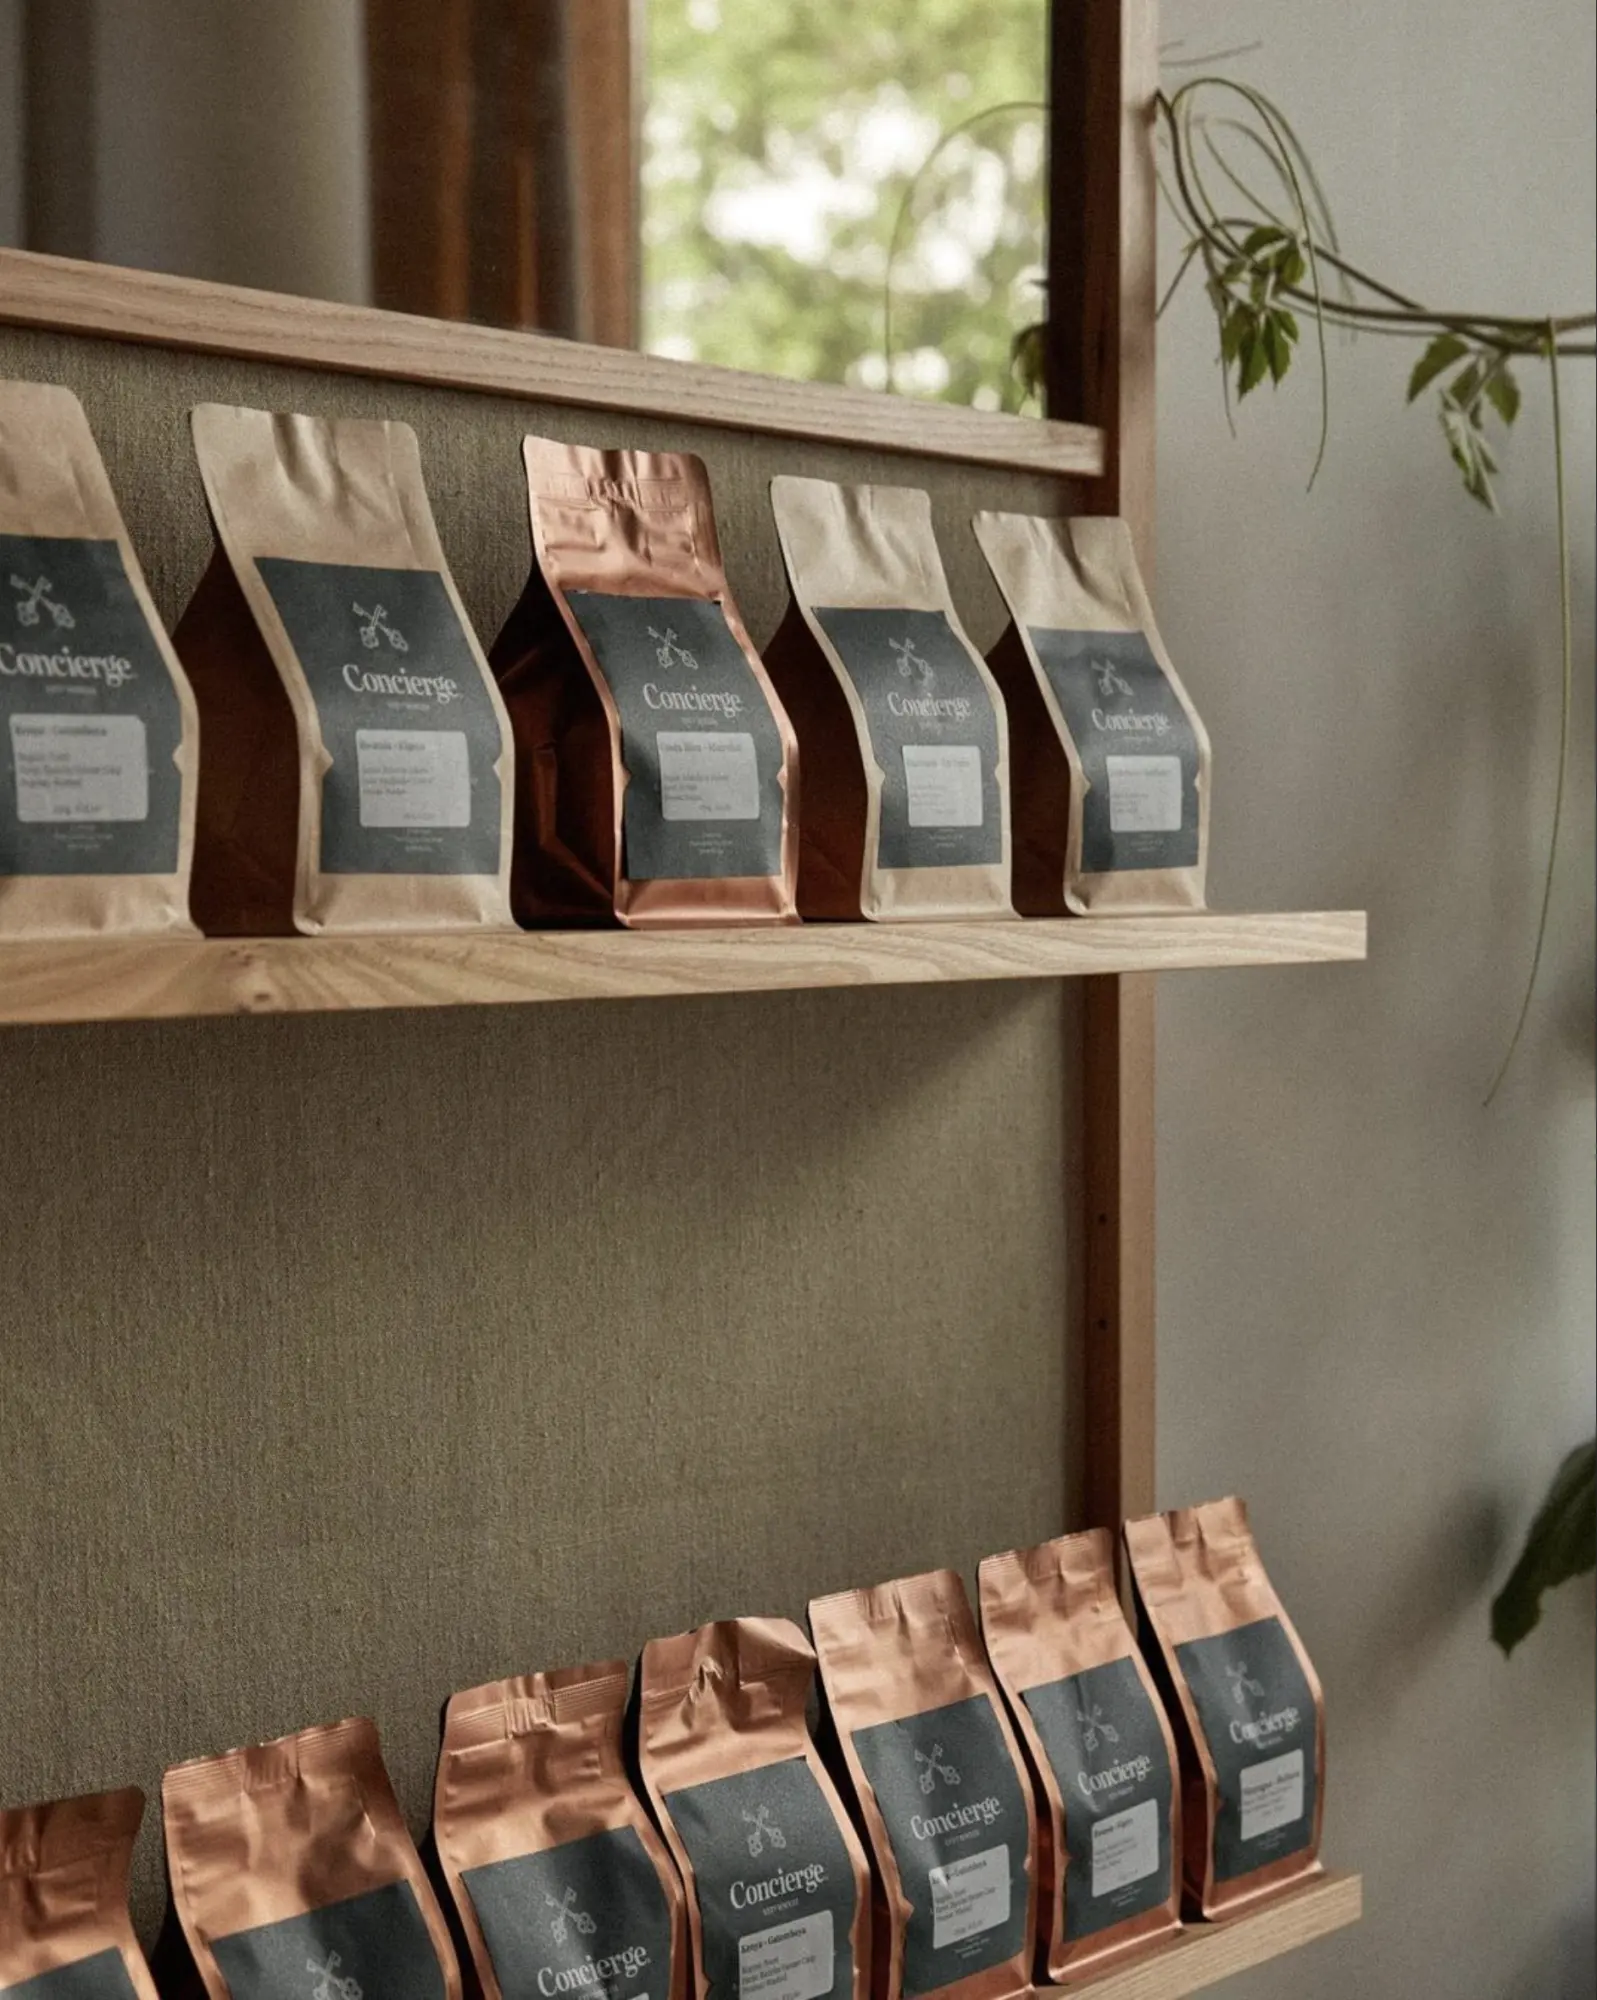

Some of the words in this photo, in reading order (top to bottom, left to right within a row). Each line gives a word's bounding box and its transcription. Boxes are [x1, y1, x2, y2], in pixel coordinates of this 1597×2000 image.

[0, 644, 132, 687] Concierge
[342, 664, 459, 703] Concierge
[642, 682, 744, 718] Concierge
[887, 691, 971, 721] Concierge
[1091, 708, 1171, 736] Concierge
[1077, 1754, 1152, 1796] Concierge
[910, 1796, 1001, 1841] Concierge
[730, 1862, 824, 1909] Concierge
[537, 1945, 648, 1997] Concierge
